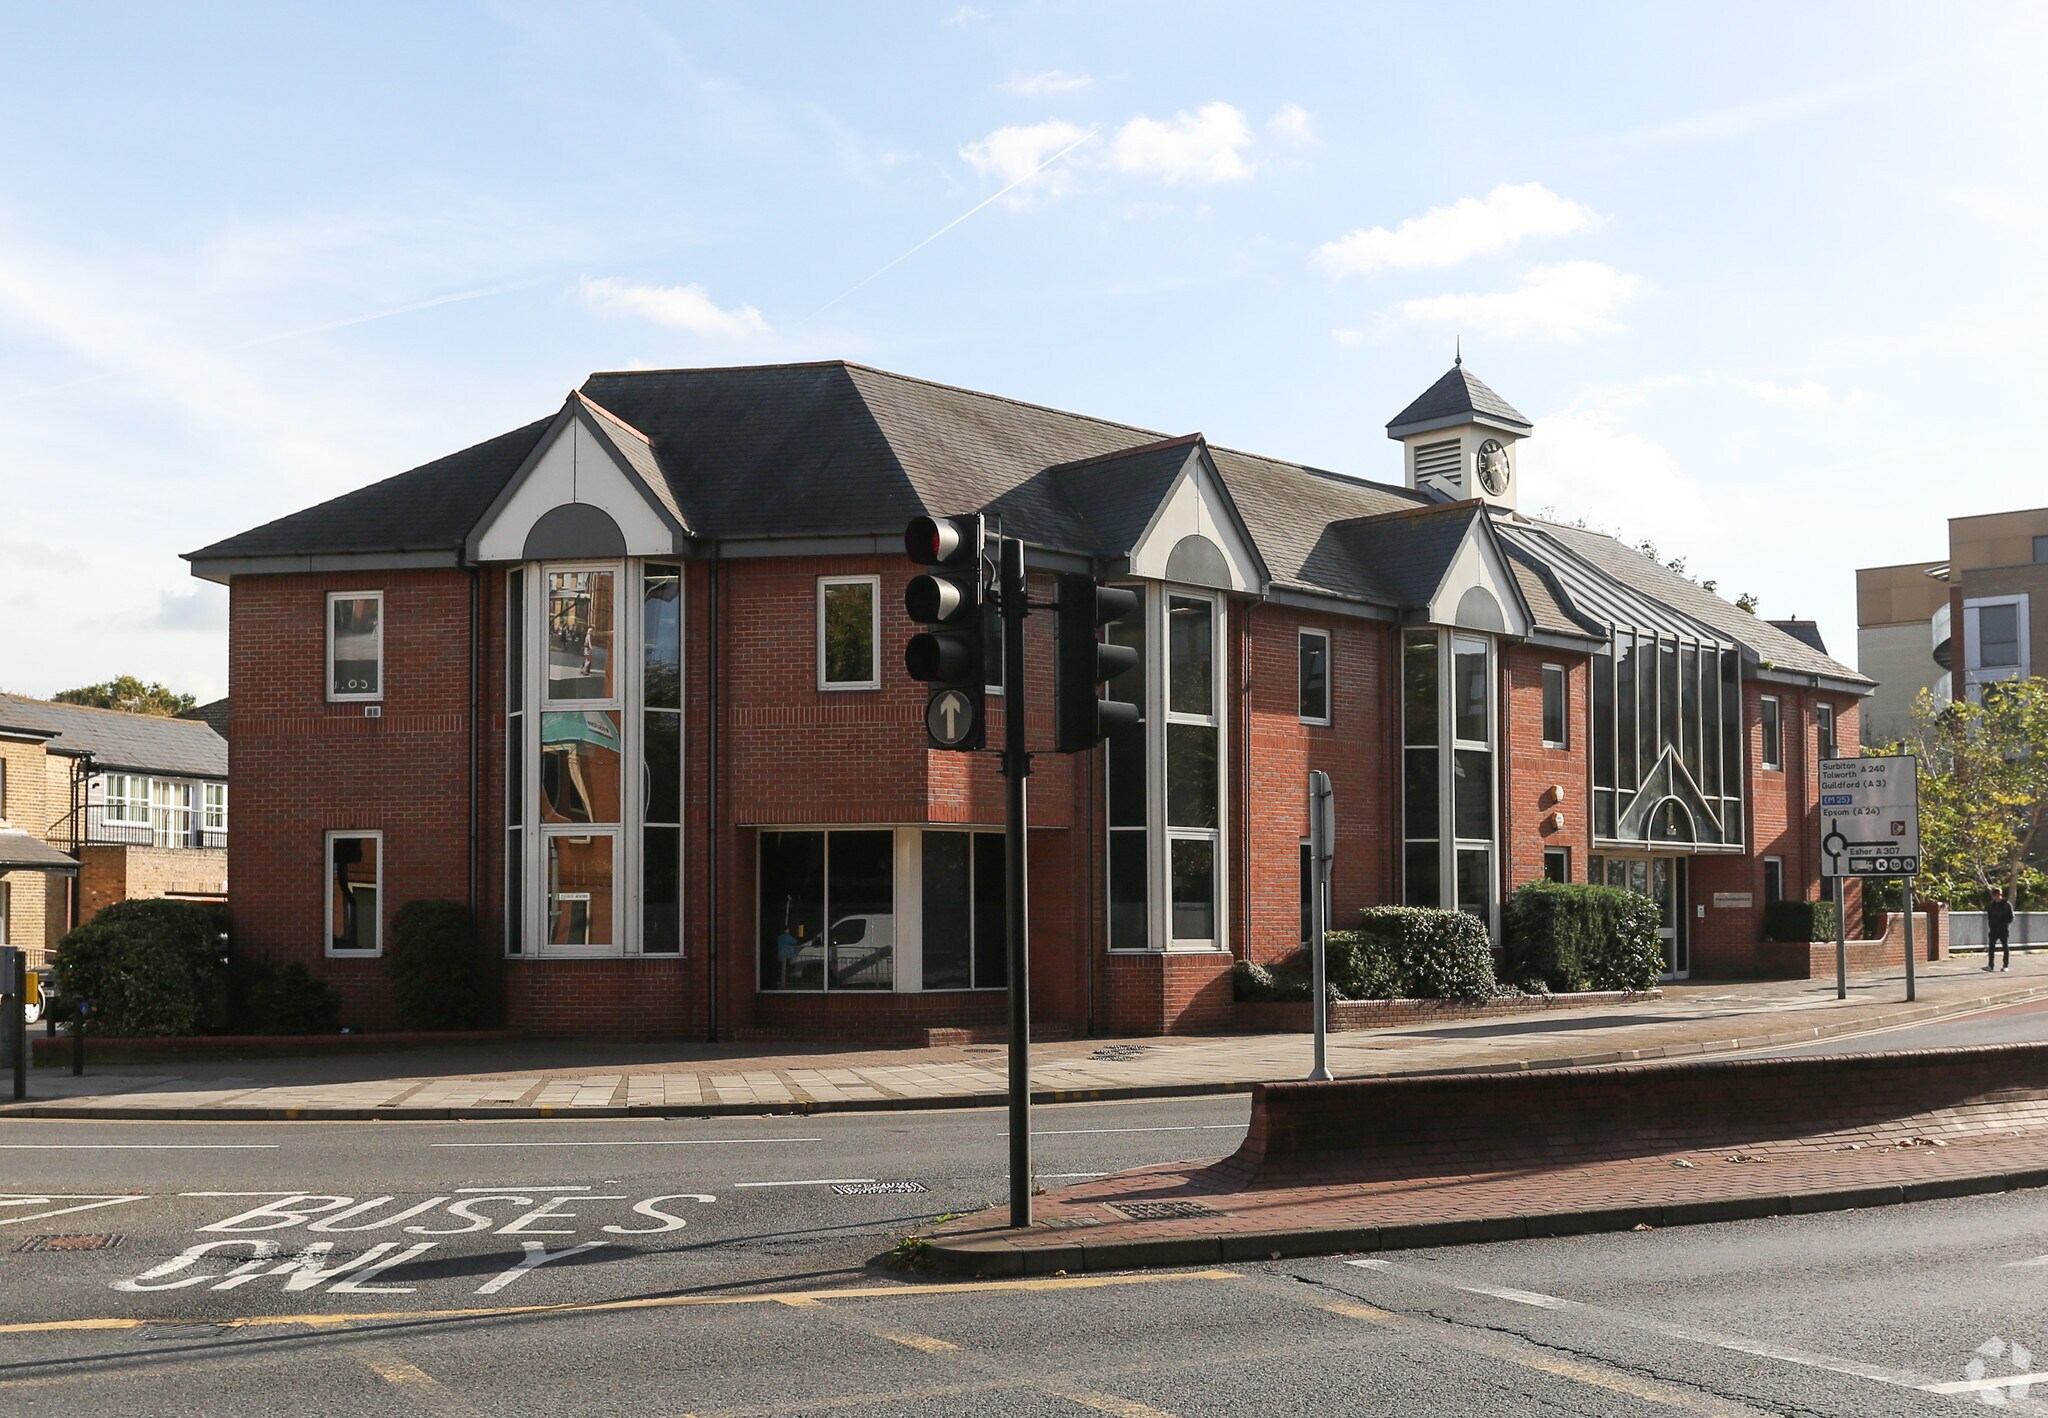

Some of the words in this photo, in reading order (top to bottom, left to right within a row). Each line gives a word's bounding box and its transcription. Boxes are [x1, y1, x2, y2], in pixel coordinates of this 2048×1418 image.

[1822, 762, 1856, 770] Surbiton
[1868, 764, 1886, 772] 240
[1823, 771, 1857, 779] Tolworth
[1822, 780, 1860, 790] Guildford
[1824, 808, 1850, 816] Epsom
[195, 1193, 717, 1235] BUSES
[109, 1239, 610, 1294] ONLY
